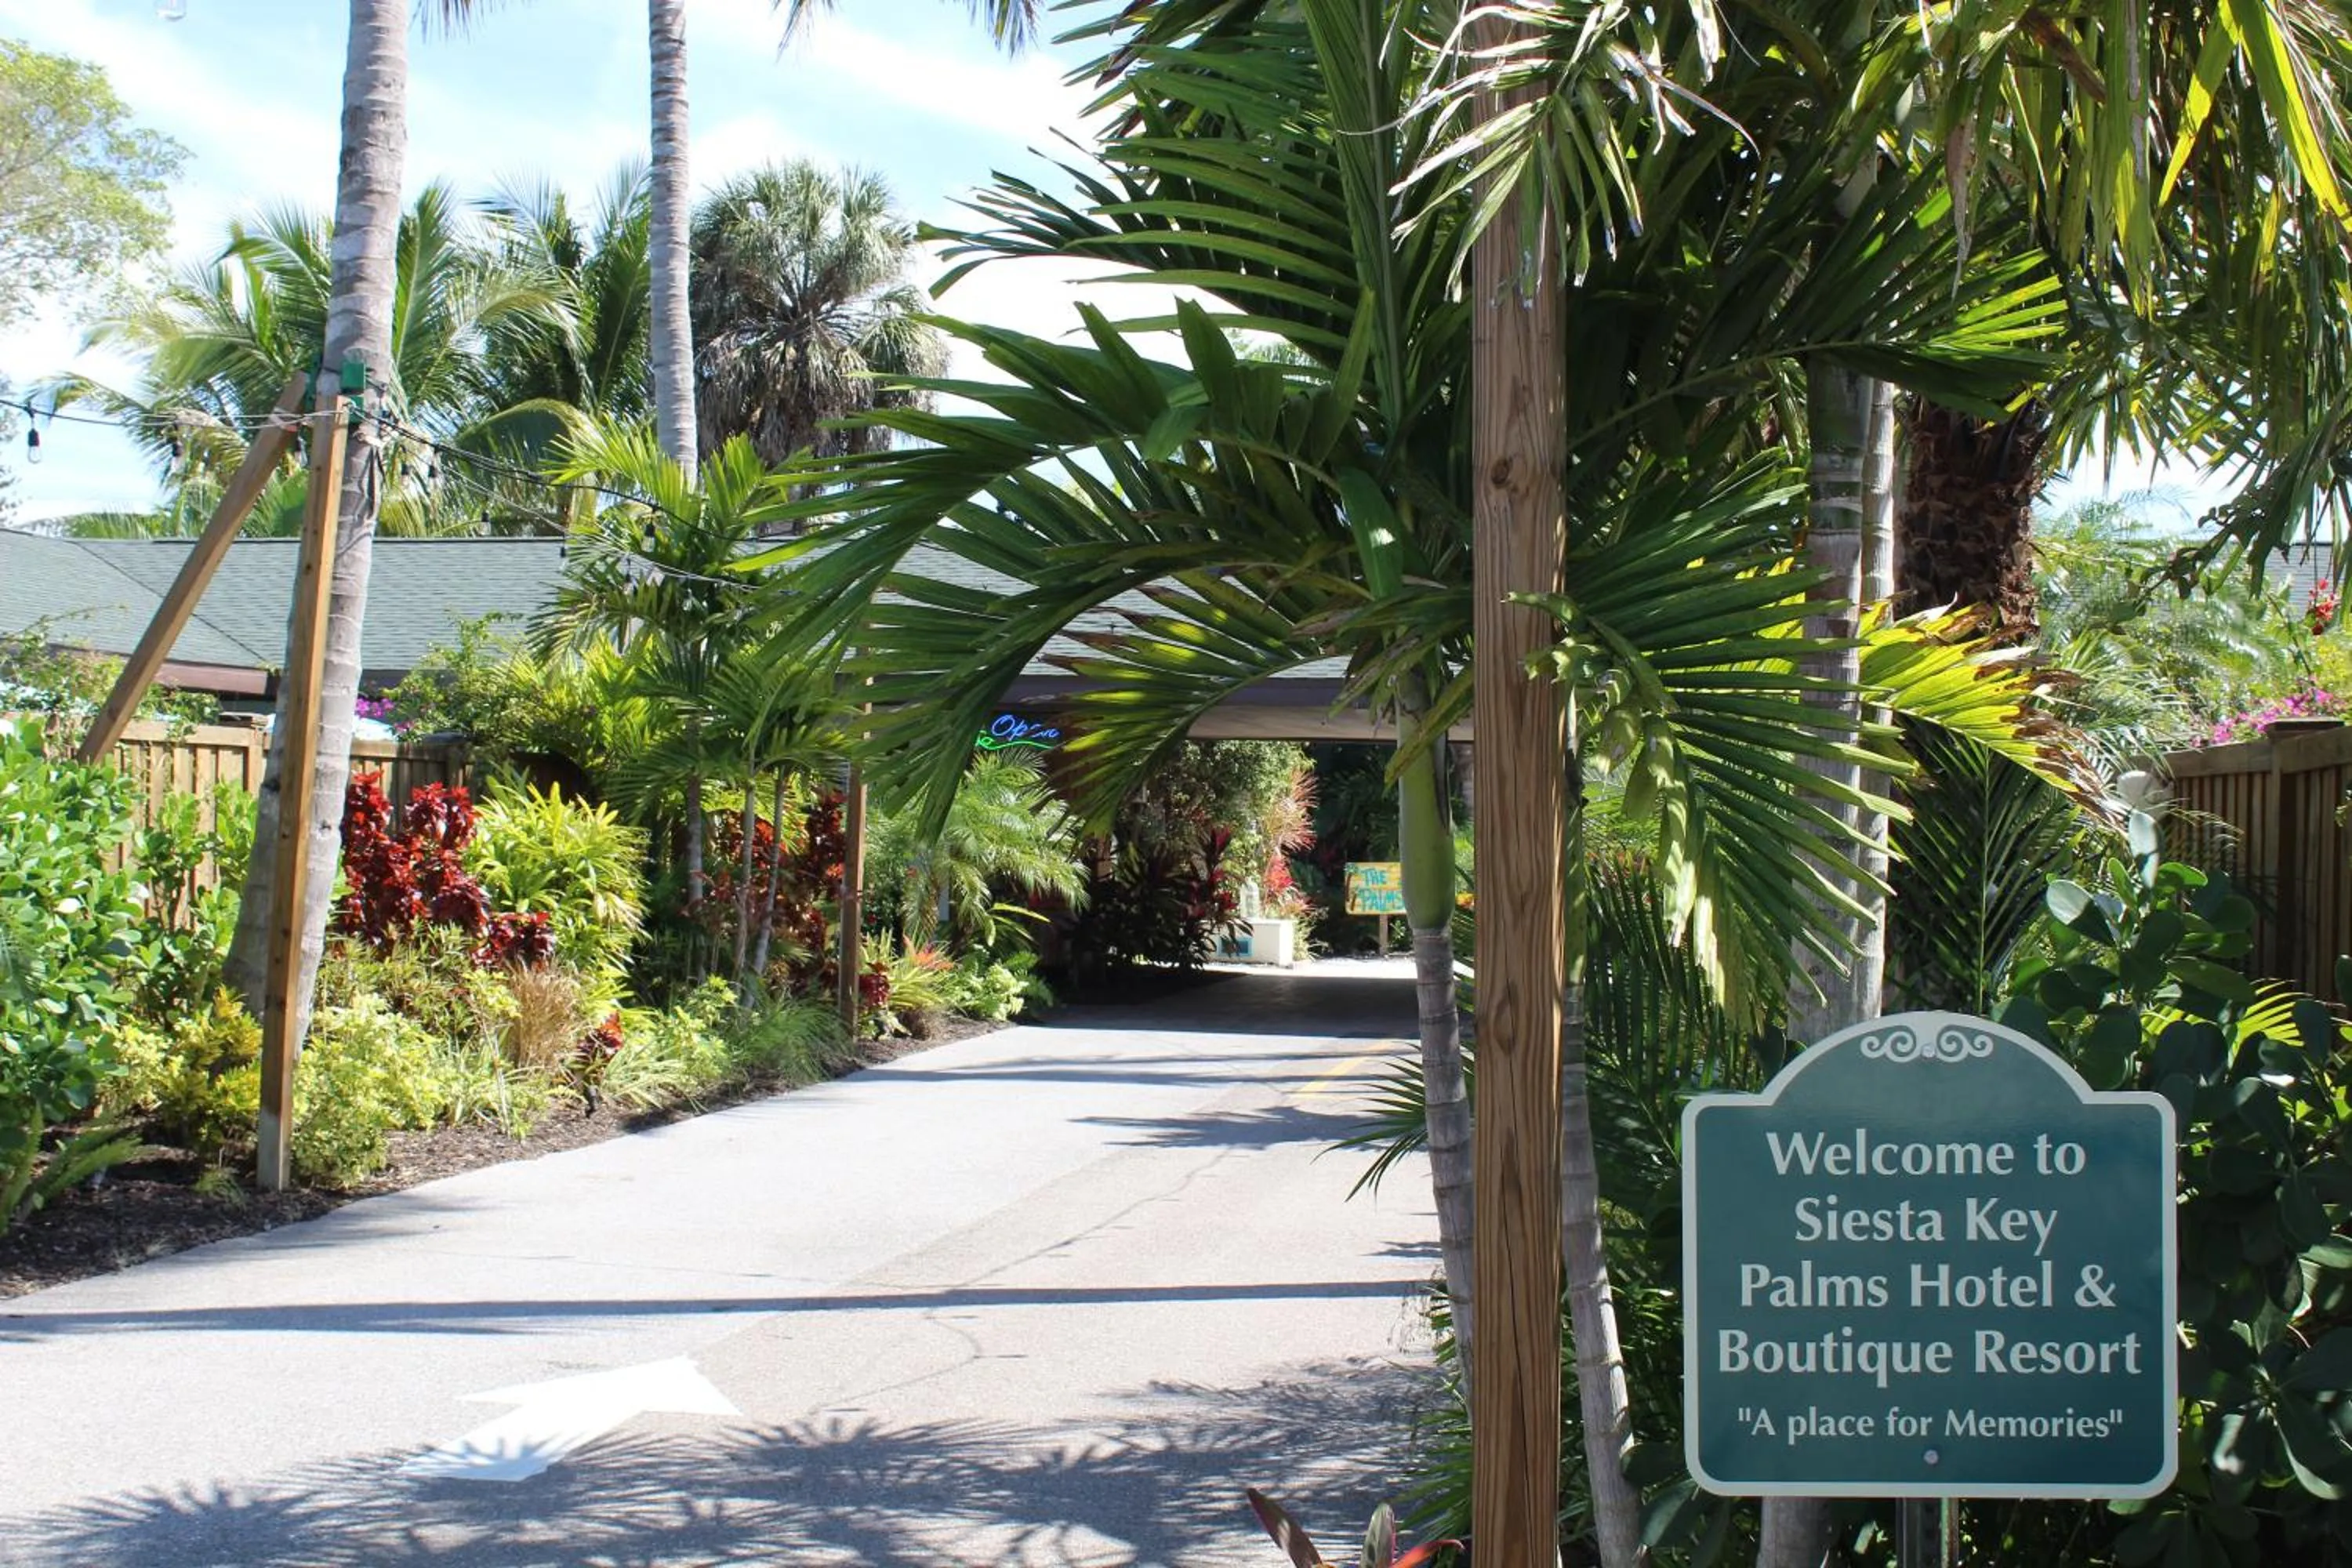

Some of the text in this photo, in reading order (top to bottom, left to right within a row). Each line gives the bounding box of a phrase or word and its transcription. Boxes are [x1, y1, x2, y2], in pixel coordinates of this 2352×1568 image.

[1361, 868, 1387, 886] THE
[1766, 1128, 2086, 1175] Welcome to
[1795, 1194, 2058, 1256] Siesta Key
[1740, 1260, 2116, 1307] Palms Hotel &
[1719, 1326, 2142, 1388] Boutique Resort
[1737, 1406, 2123, 1446] "A place for Memories"
